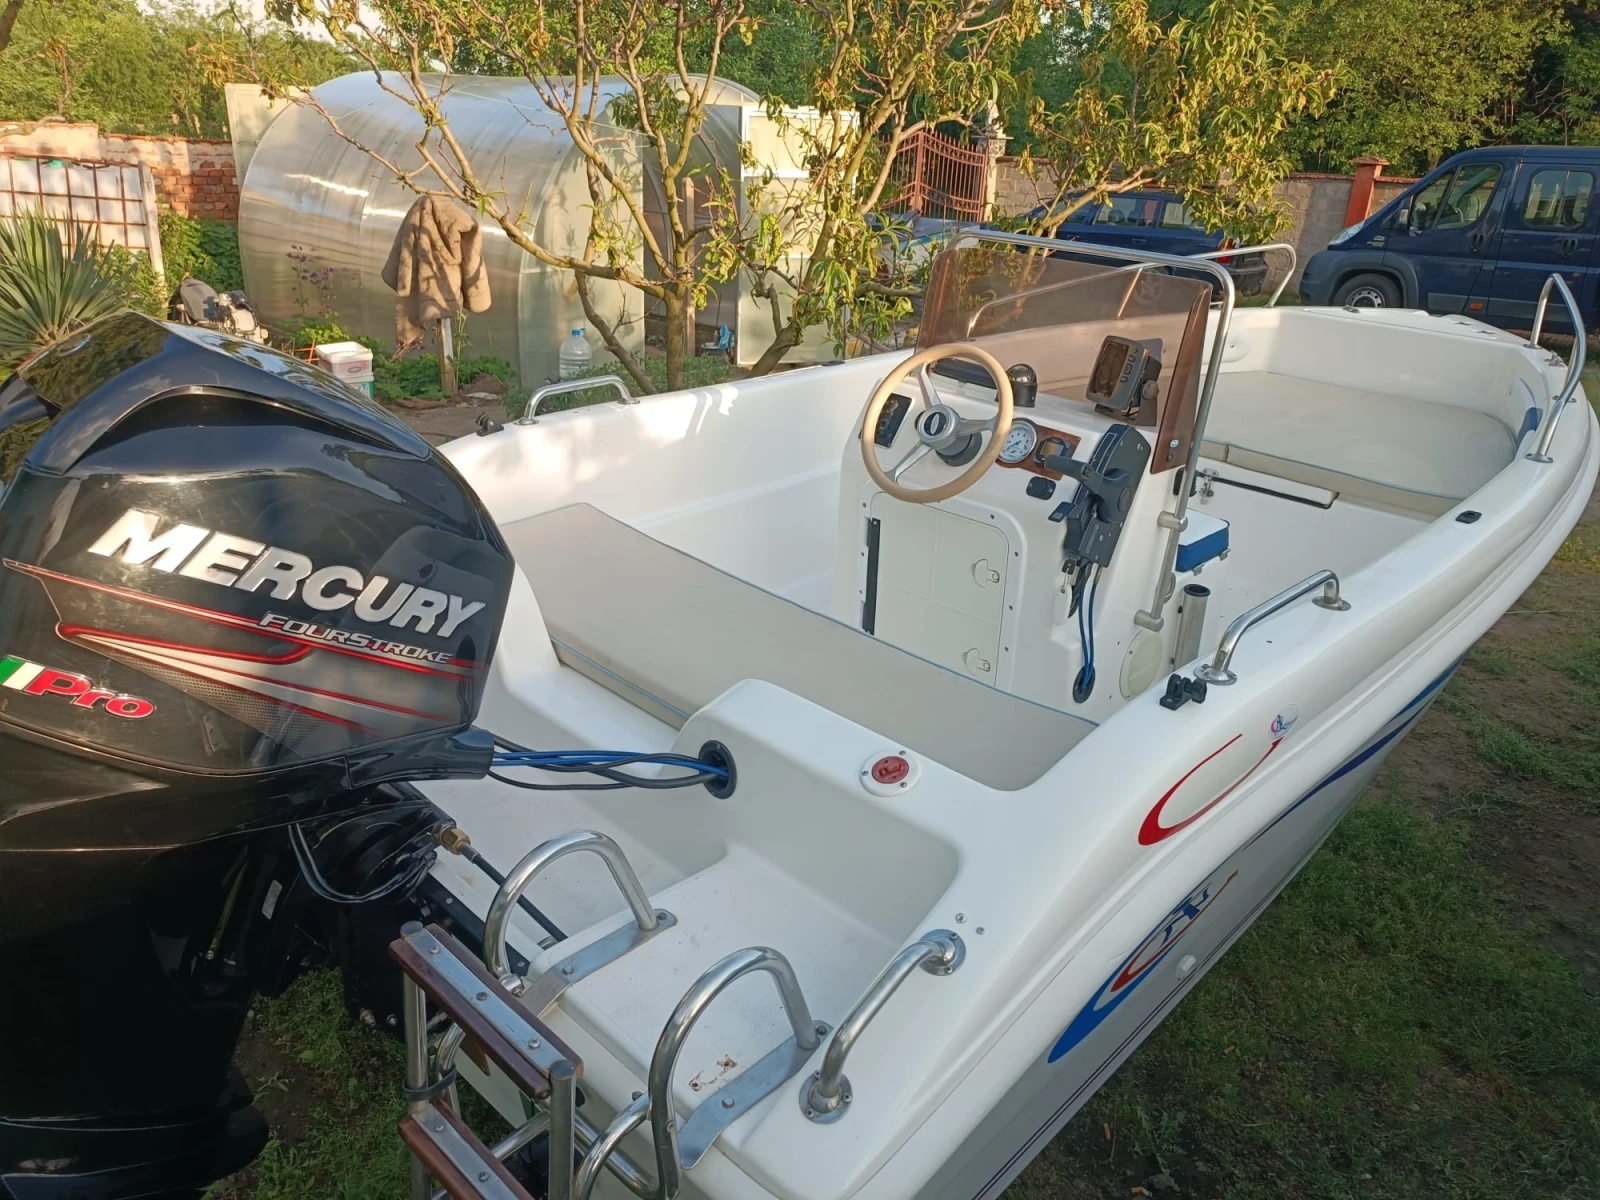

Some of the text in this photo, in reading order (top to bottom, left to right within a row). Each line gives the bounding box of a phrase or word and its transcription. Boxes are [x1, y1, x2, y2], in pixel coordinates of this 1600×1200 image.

[87, 508, 486, 639] MERCURY
[258, 611, 454, 666] FOURSTROKE
[26, 669, 156, 720] Pro
